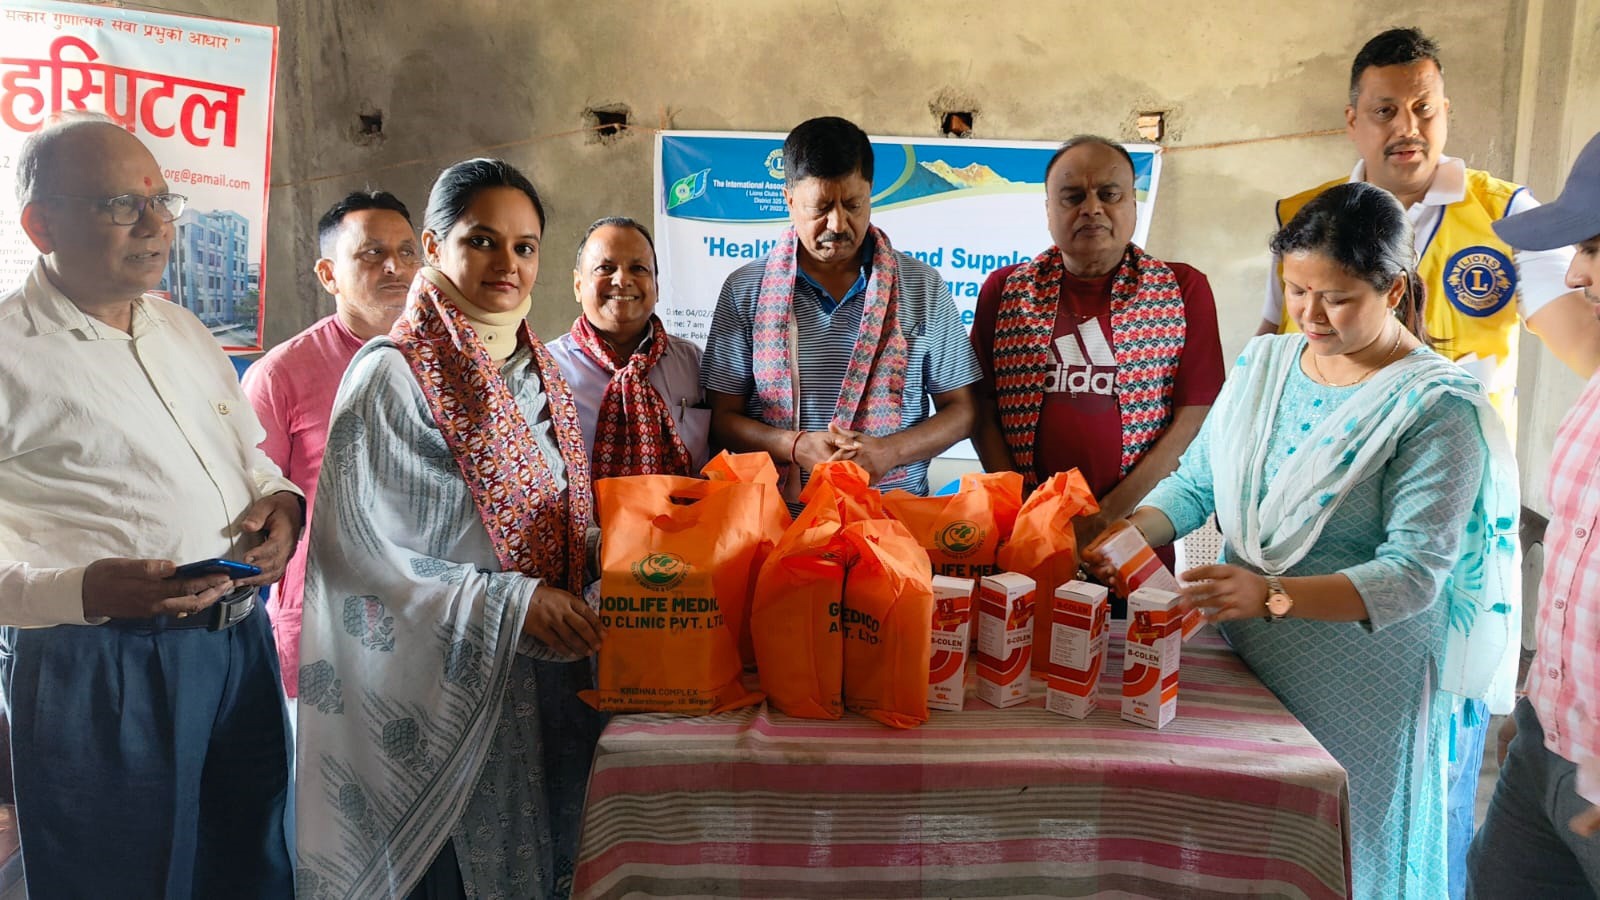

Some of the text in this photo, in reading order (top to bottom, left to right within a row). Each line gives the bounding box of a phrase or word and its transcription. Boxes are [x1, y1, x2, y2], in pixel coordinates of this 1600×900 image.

[189, 31, 228, 49] आधार
[713, 179, 724, 188] The
[726, 180, 764, 189] International
[1460, 255, 1498, 269] LIONS
[1471, 269, 1488, 291] L
[615, 616, 666, 629] CLINIC
[670, 617, 703, 629] PVT.
[1127, 648, 1160, 663] B-COLEN
